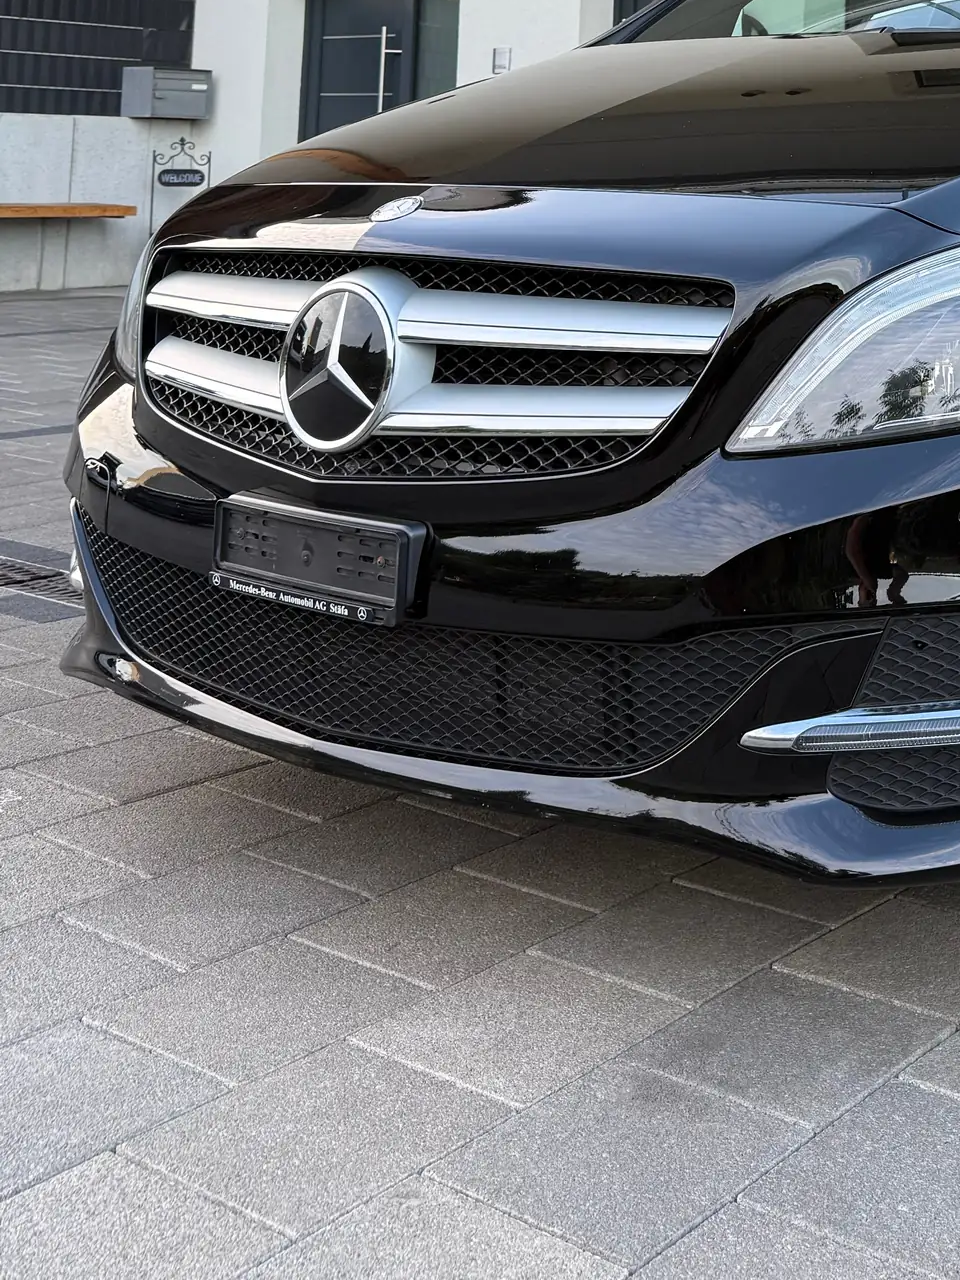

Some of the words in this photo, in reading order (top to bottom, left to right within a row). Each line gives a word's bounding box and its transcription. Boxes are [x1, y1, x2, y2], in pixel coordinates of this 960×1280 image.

[161, 173, 202, 183] WELCOME
[229, 579, 277, 600] Mercedes-Benz
[279, 592, 313, 609] Automobil
[314, 600, 327, 611] AG
[329, 602, 349, 616] Stäfa
